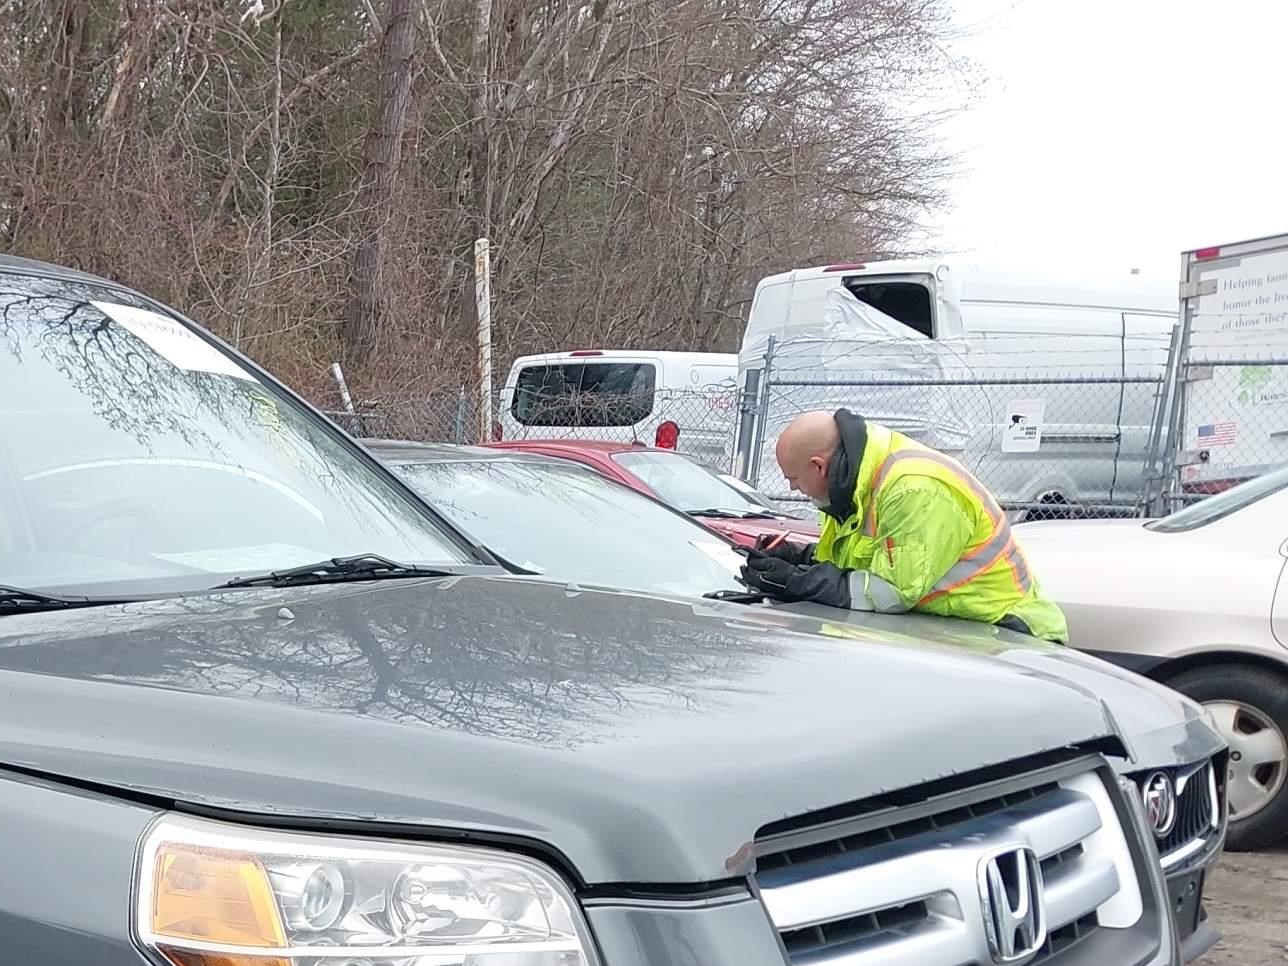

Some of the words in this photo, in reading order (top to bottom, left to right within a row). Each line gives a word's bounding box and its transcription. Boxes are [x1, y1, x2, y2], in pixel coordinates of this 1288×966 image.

[1223, 277, 1263, 291] Helping
[1223, 299, 1252, 311] honor
[1255, 295, 1271, 305] the
[1222, 319, 1232, 330] of
[1235, 314, 1260, 328] those
[1264, 312, 1287, 325] they
